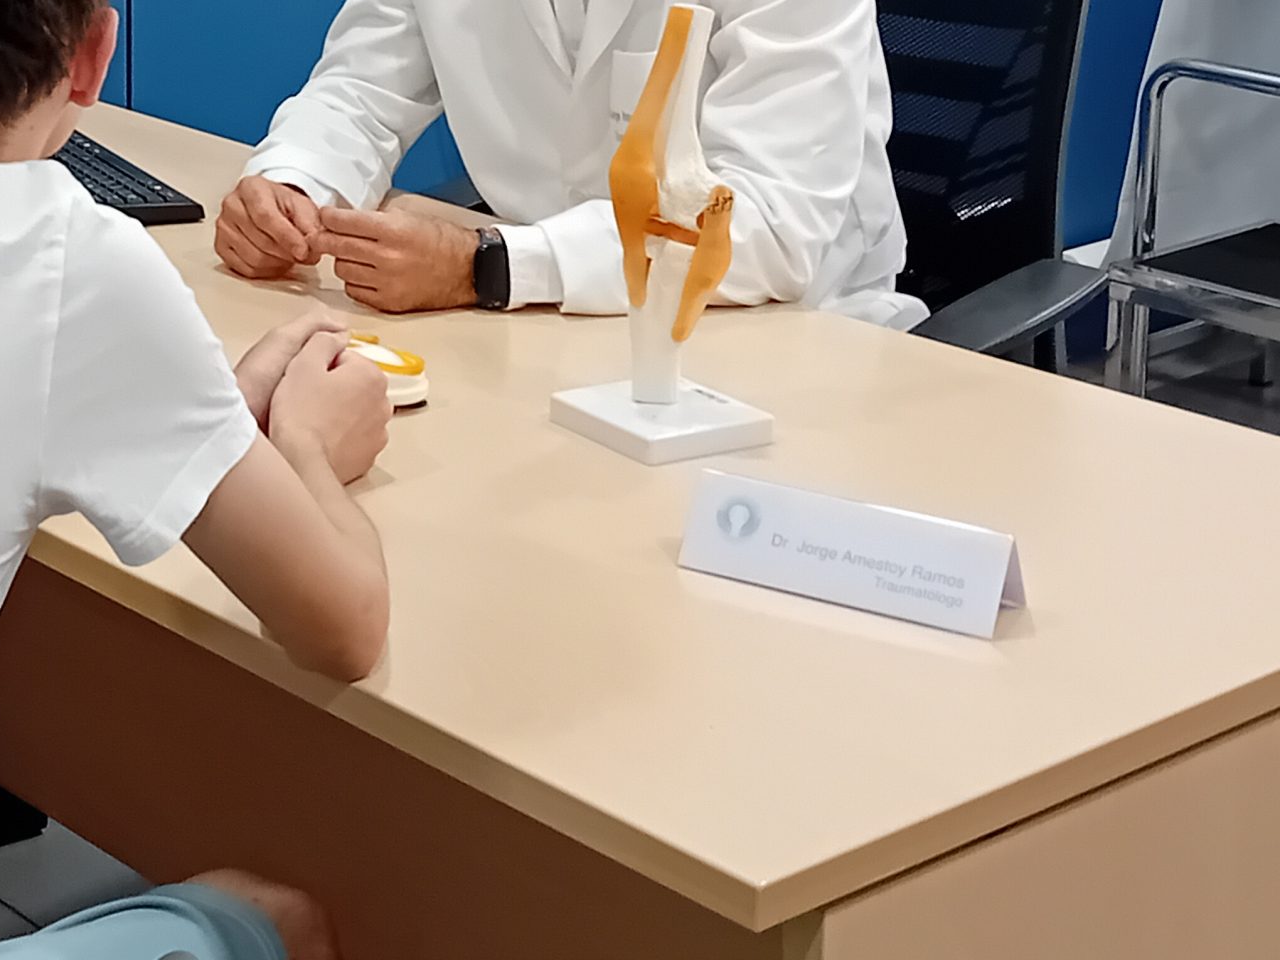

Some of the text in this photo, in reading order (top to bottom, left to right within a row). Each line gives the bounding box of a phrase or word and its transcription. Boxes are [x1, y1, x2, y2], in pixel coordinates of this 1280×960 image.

[796, 540, 838, 561] Jorge
[842, 550, 907, 577] Amestoy
[911, 565, 965, 589] Ramos
